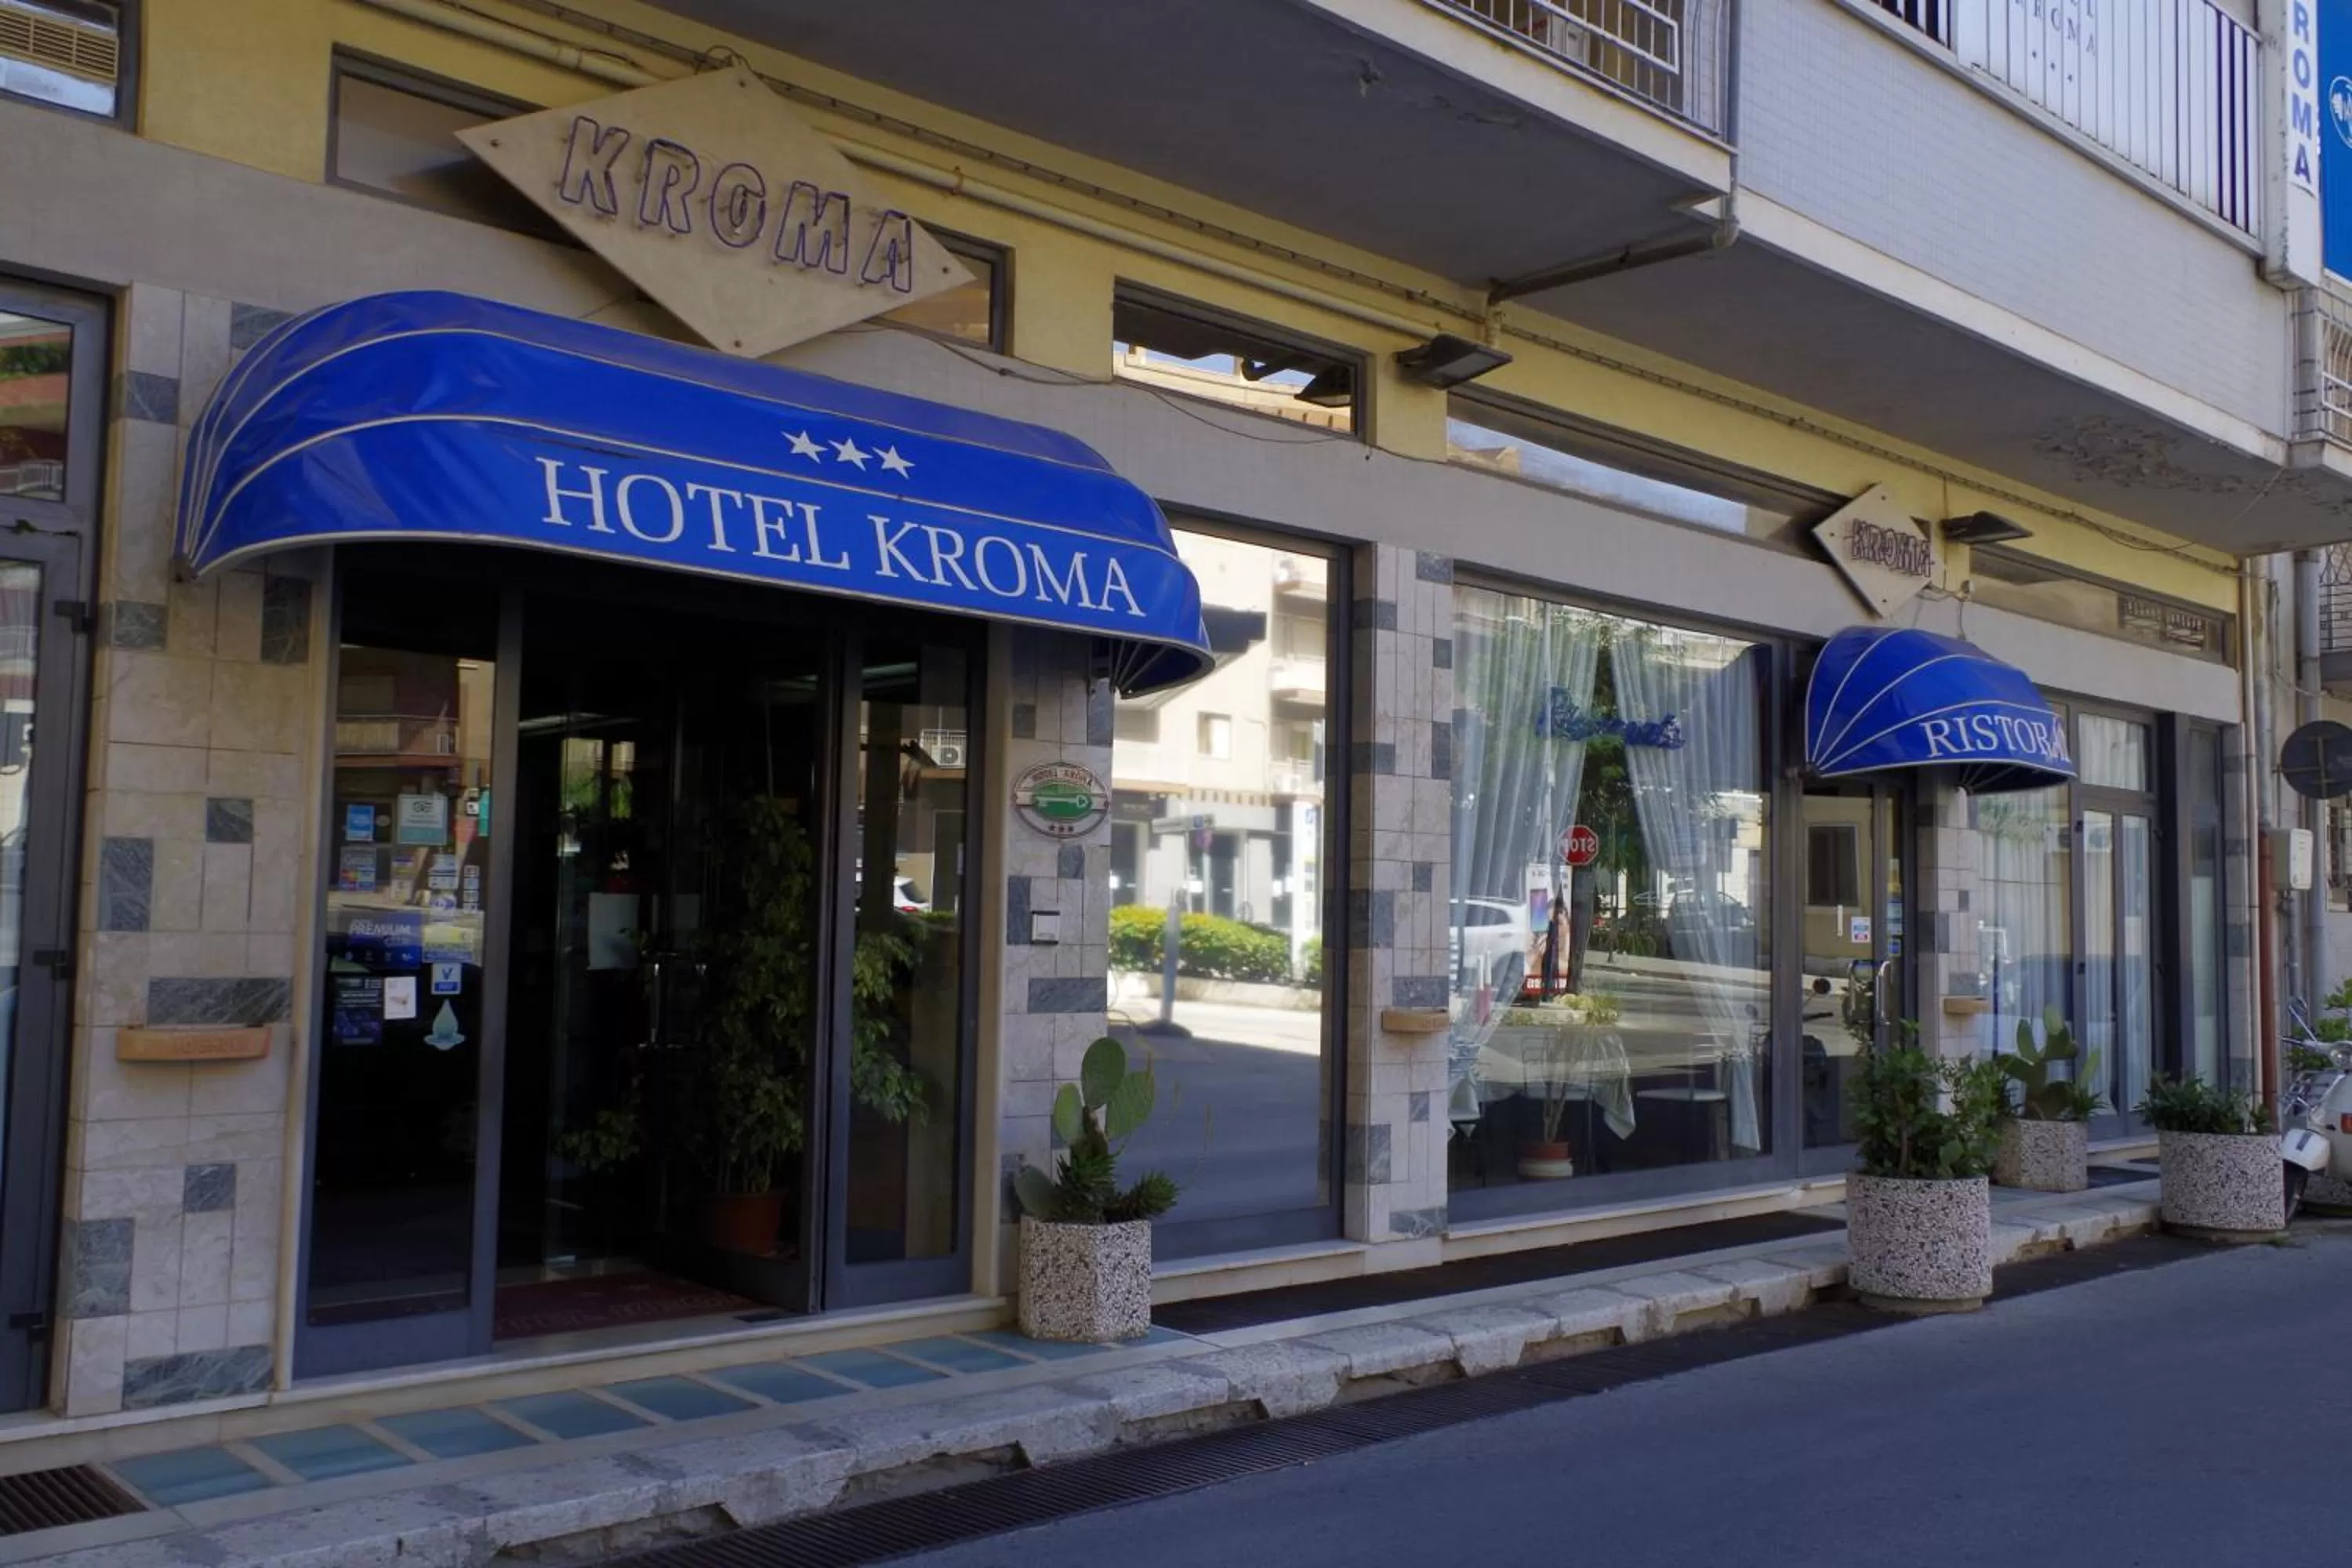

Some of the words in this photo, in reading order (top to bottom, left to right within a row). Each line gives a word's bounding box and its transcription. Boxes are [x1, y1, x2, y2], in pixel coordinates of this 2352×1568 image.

[560, 115, 913, 293] KROMA
[535, 456, 851, 570] HOTEL
[867, 514, 1147, 617] KROMA
[1851, 517, 1931, 577] KROMA
